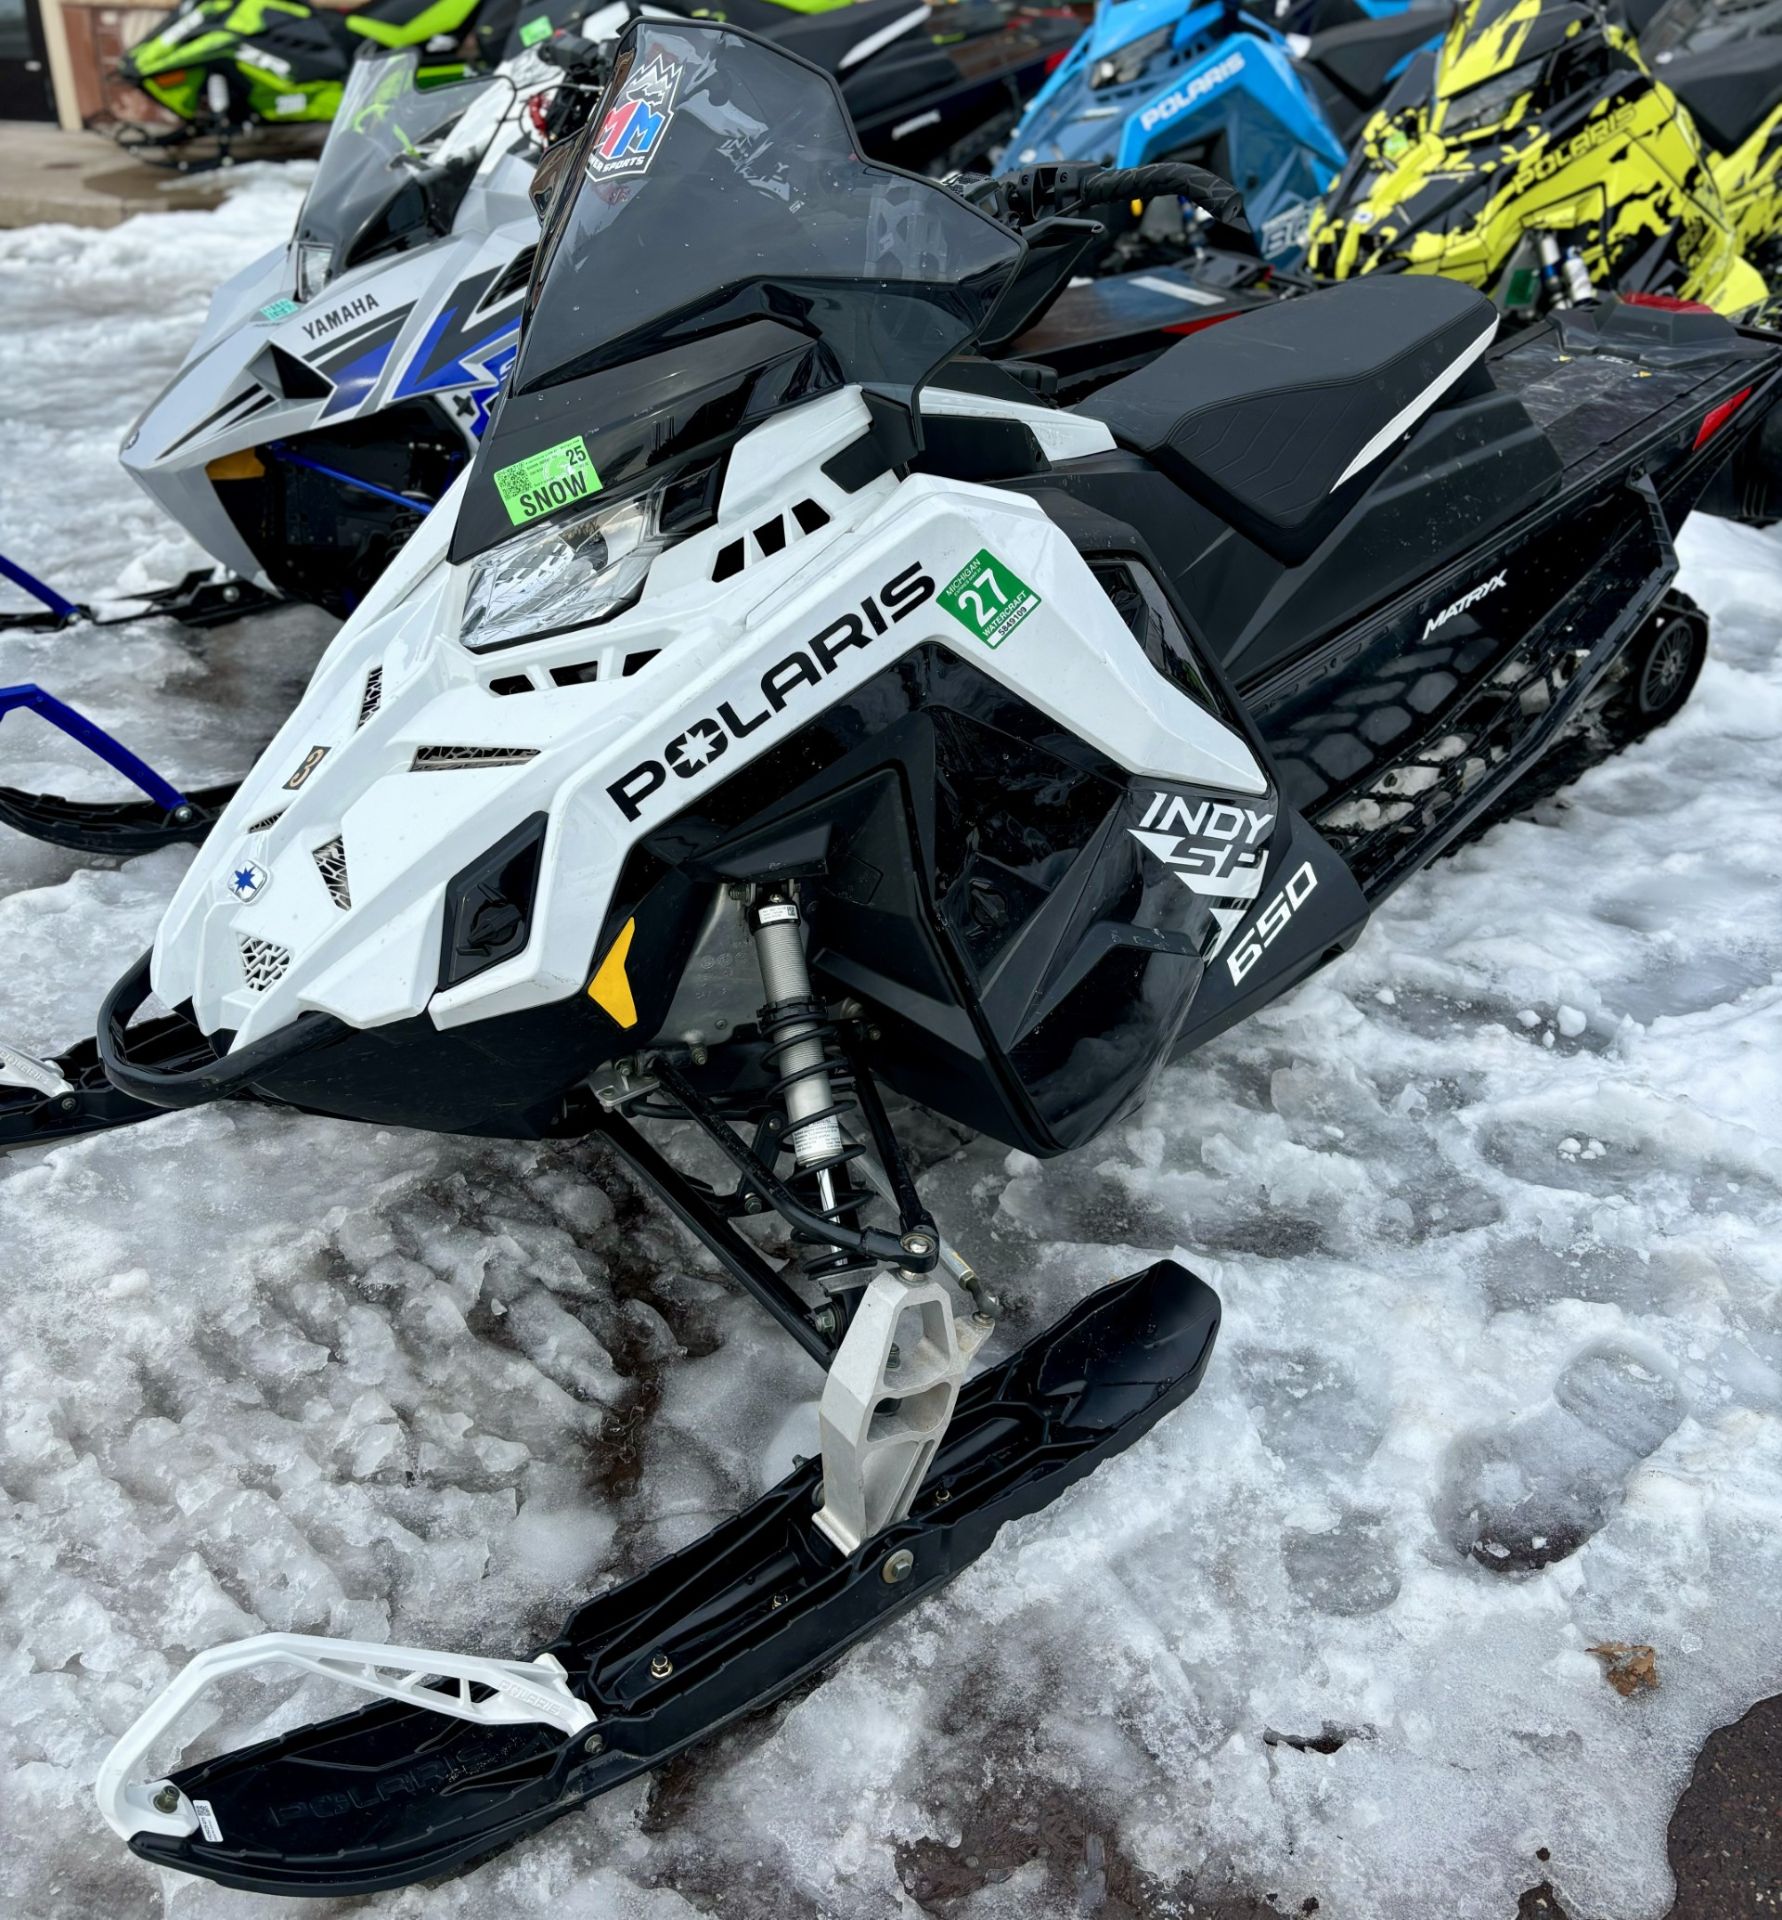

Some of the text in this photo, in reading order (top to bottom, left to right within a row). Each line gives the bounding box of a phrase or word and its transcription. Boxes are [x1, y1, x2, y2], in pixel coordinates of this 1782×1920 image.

[1140, 52, 1245, 131] POLARIS
[602, 156, 645, 172] SPORTS
[1512, 102, 1636, 194] POLARIS
[301, 293, 379, 340] YAMAHA
[566, 445, 587, 466] 25
[520, 471, 587, 517] SNOW
[946, 559, 981, 597] MICHIGAN
[958, 568, 1009, 627] 27
[983, 590, 1027, 637] WATERCRAFT
[998, 606, 1027, 636] 5849109
[1422, 568, 1508, 640] MATRYX
[606, 561, 935, 822] POLARIS
[1139, 792, 1274, 843] INDY
[1166, 837, 1262, 878] SP
[1227, 861, 1318, 987] 650
[500, 1680, 561, 1716] POLARIS
[269, 1745, 488, 1828] POLARIS
